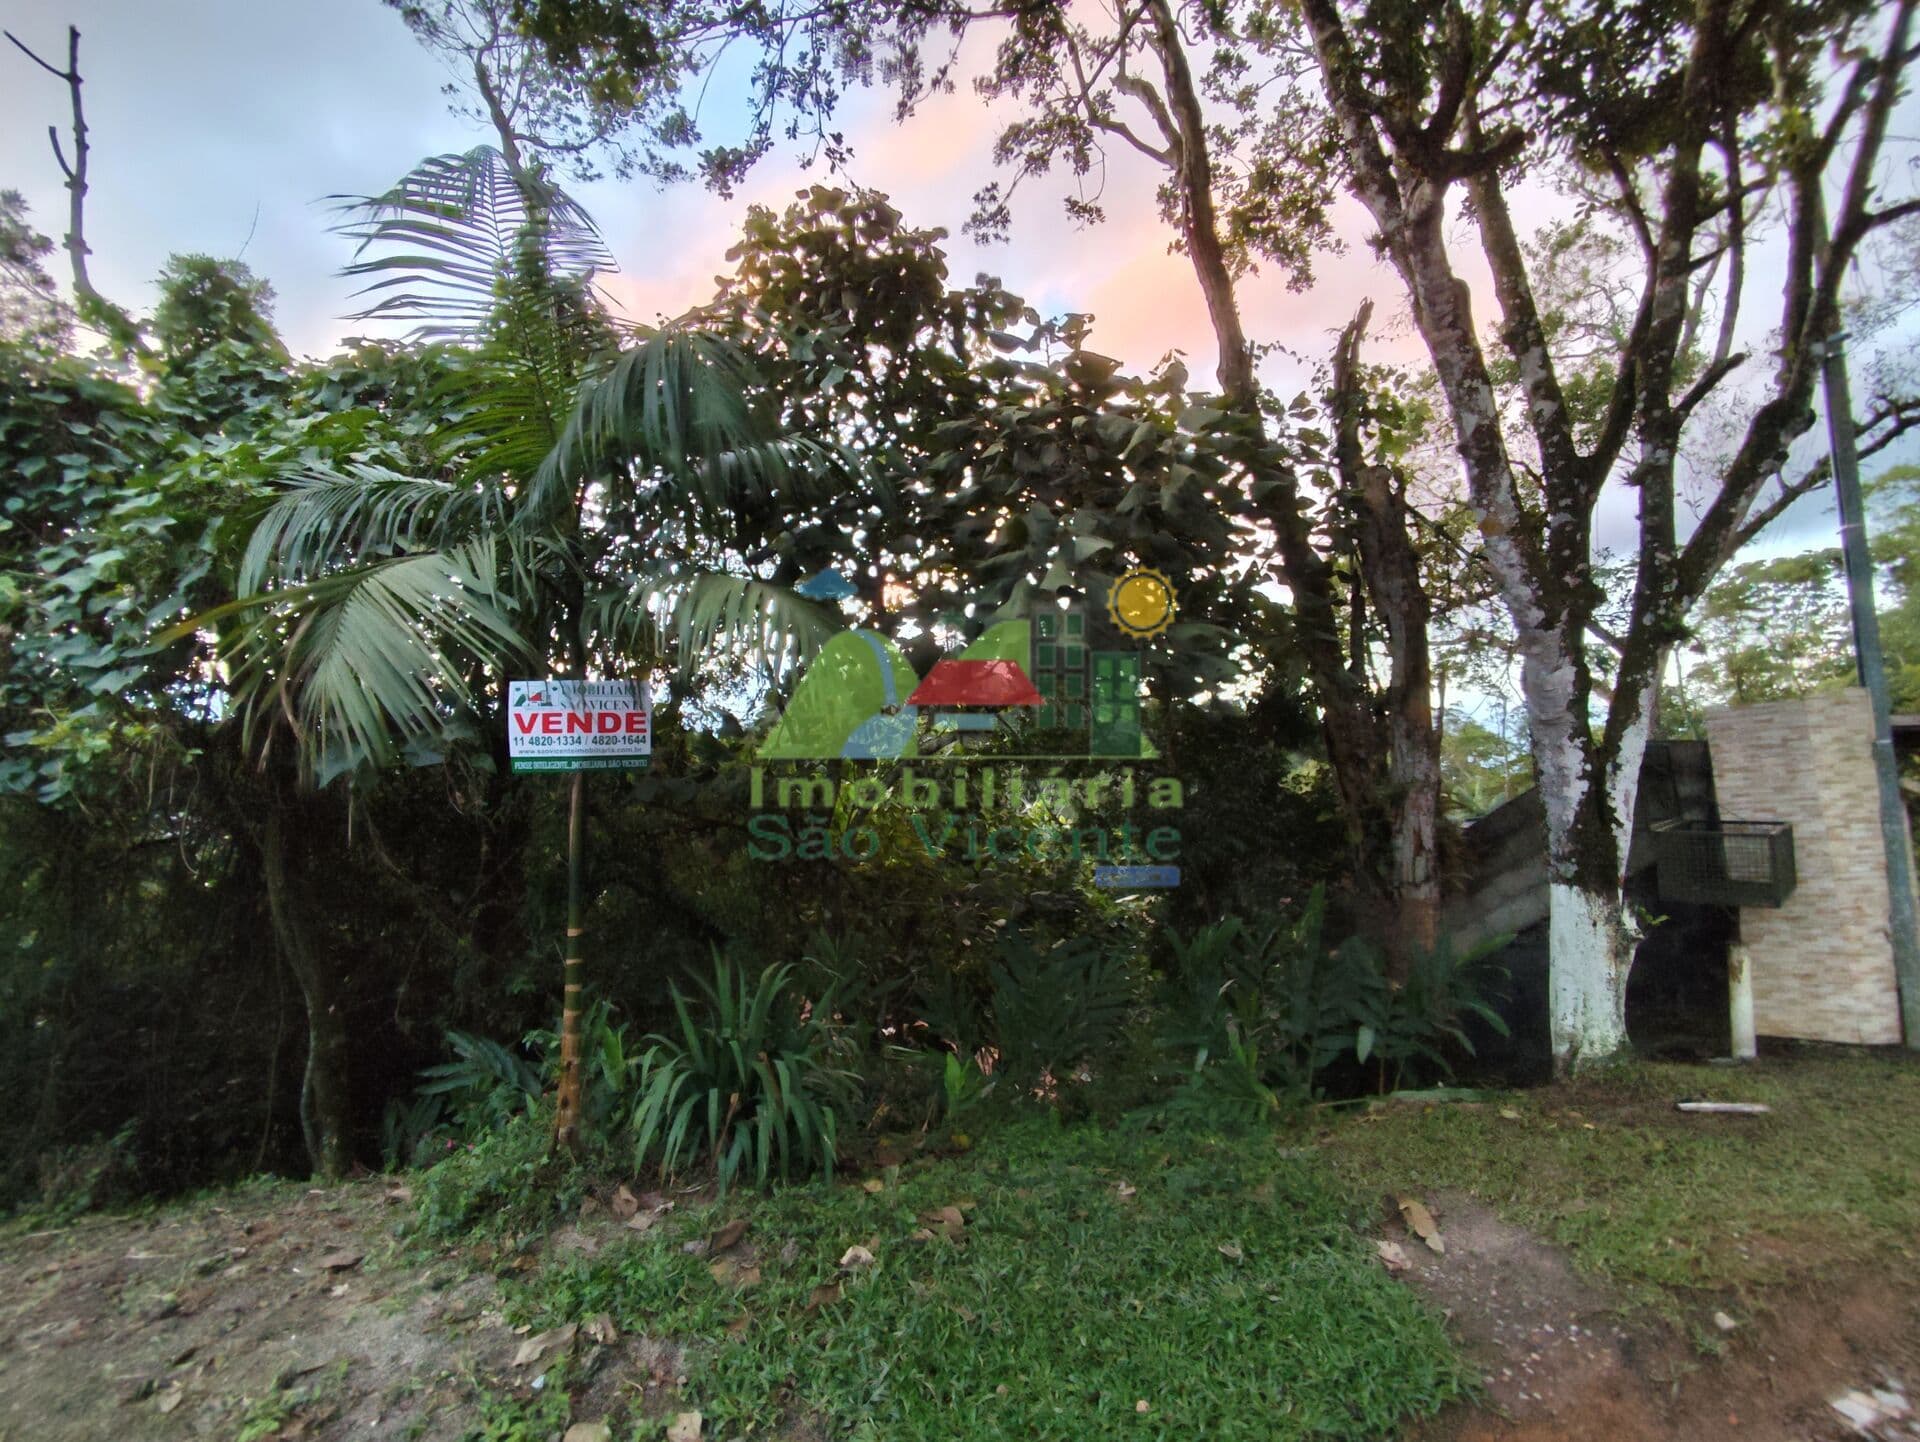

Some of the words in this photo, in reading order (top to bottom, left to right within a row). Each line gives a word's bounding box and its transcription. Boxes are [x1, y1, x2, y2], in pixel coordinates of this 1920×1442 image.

[513, 712, 647, 734] VENDE
[514, 737, 524, 747] 11
[528, 736, 582, 747] 4820-1334
[591, 735, 647, 746] 4820-1644
